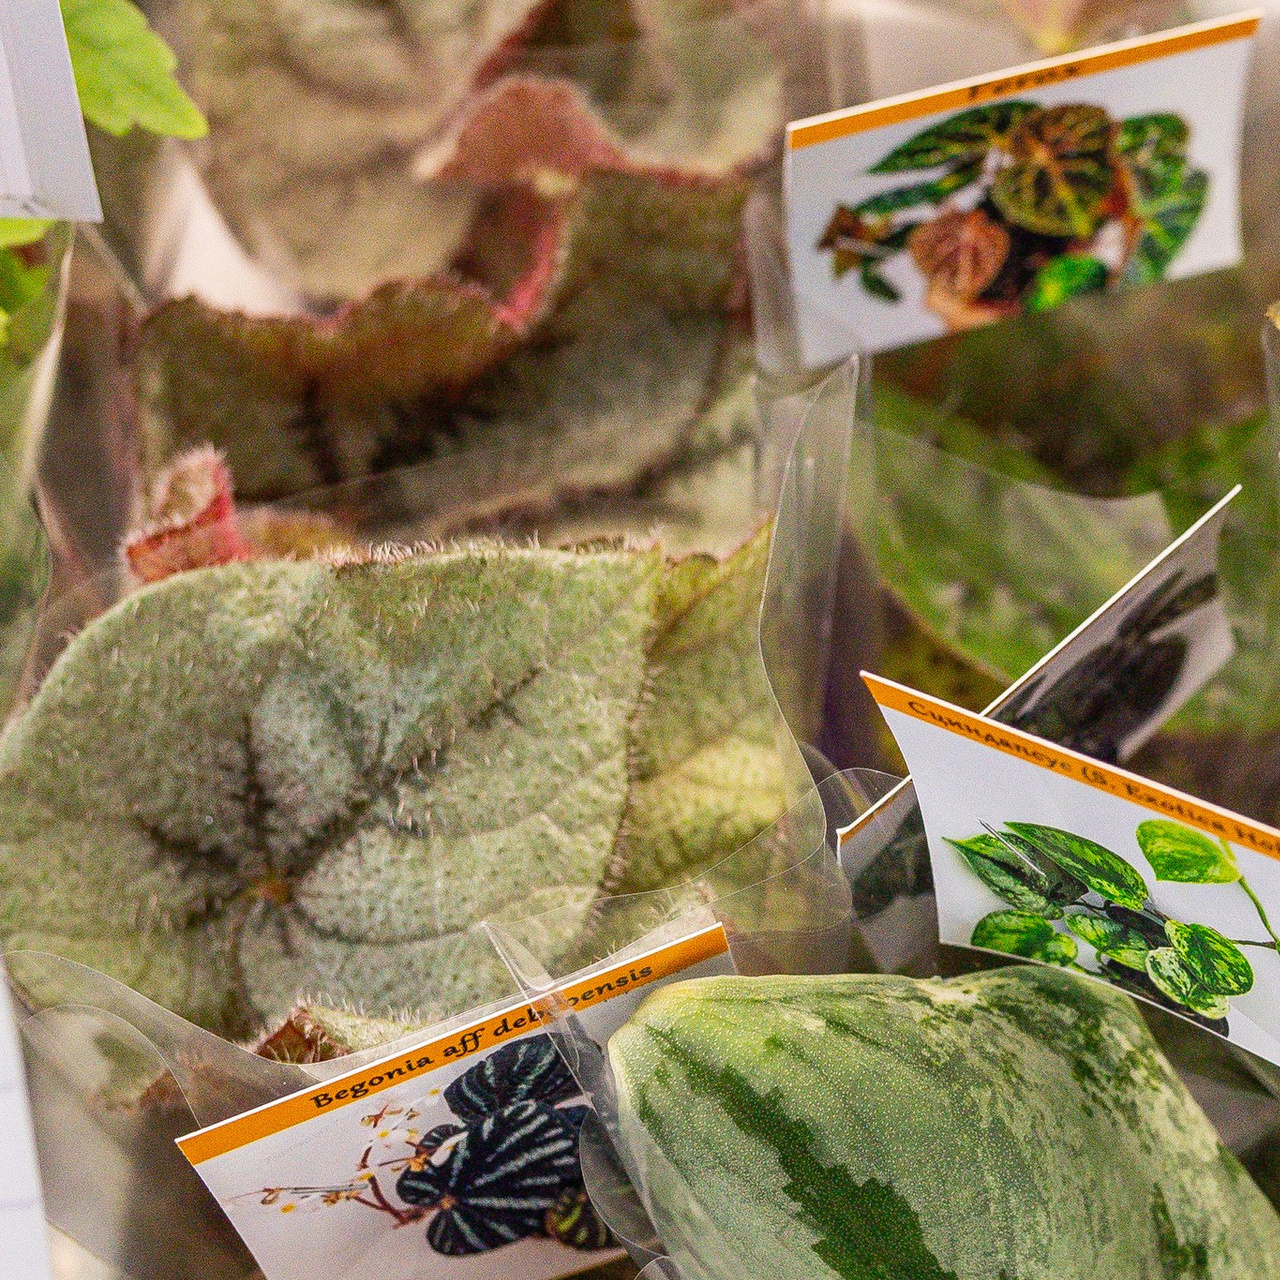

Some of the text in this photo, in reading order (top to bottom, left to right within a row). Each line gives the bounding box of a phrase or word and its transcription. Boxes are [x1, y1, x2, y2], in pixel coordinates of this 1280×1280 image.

[310, 964, 653, 1109] Begonia aff deboensis
